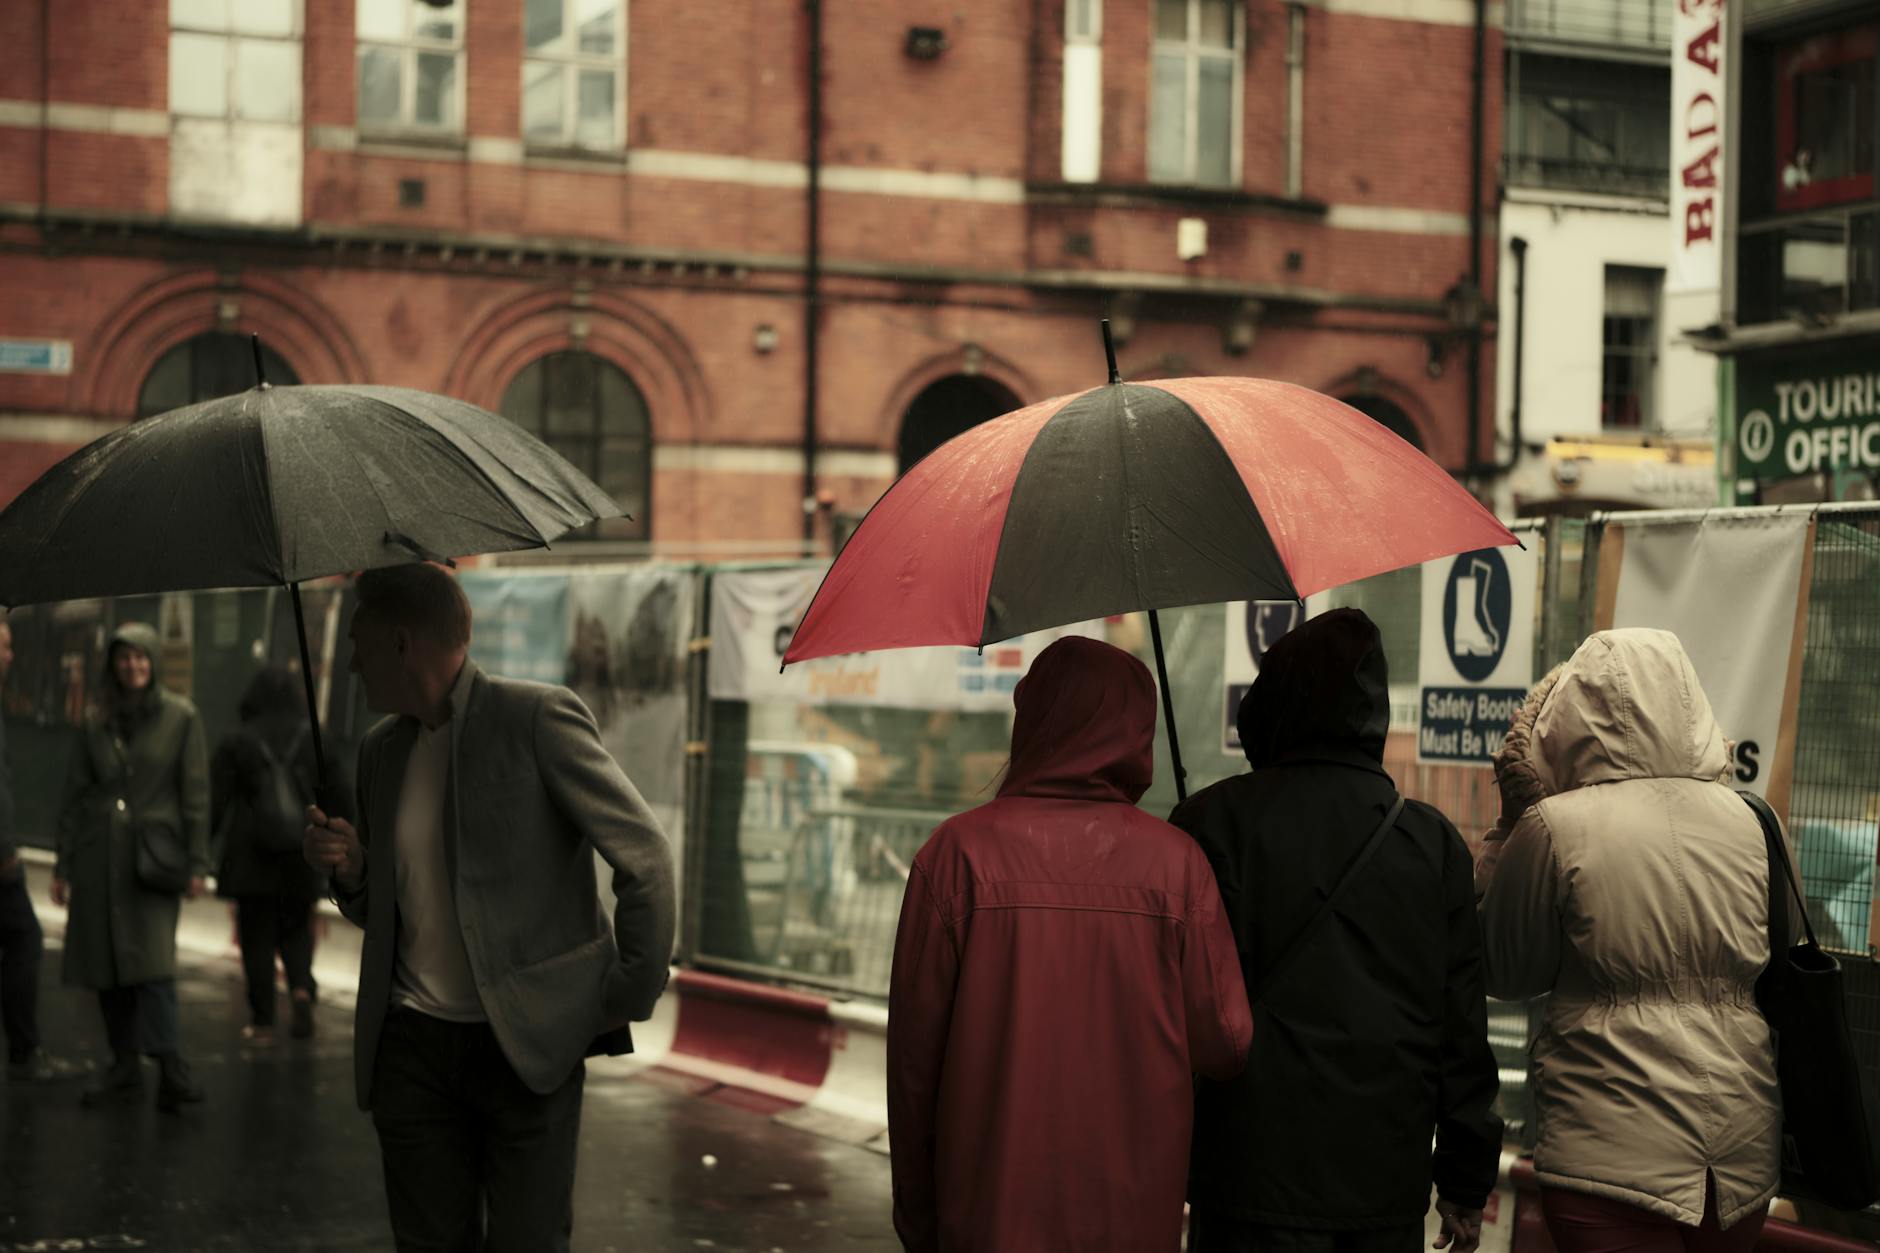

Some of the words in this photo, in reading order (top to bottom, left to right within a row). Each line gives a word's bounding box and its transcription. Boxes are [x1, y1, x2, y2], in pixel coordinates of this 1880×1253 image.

[1775, 372, 1880, 423] TOURI
[1427, 692, 1474, 726] Safety
[1422, 728, 1458, 755] Must
[1461, 729, 1481, 756] Be
